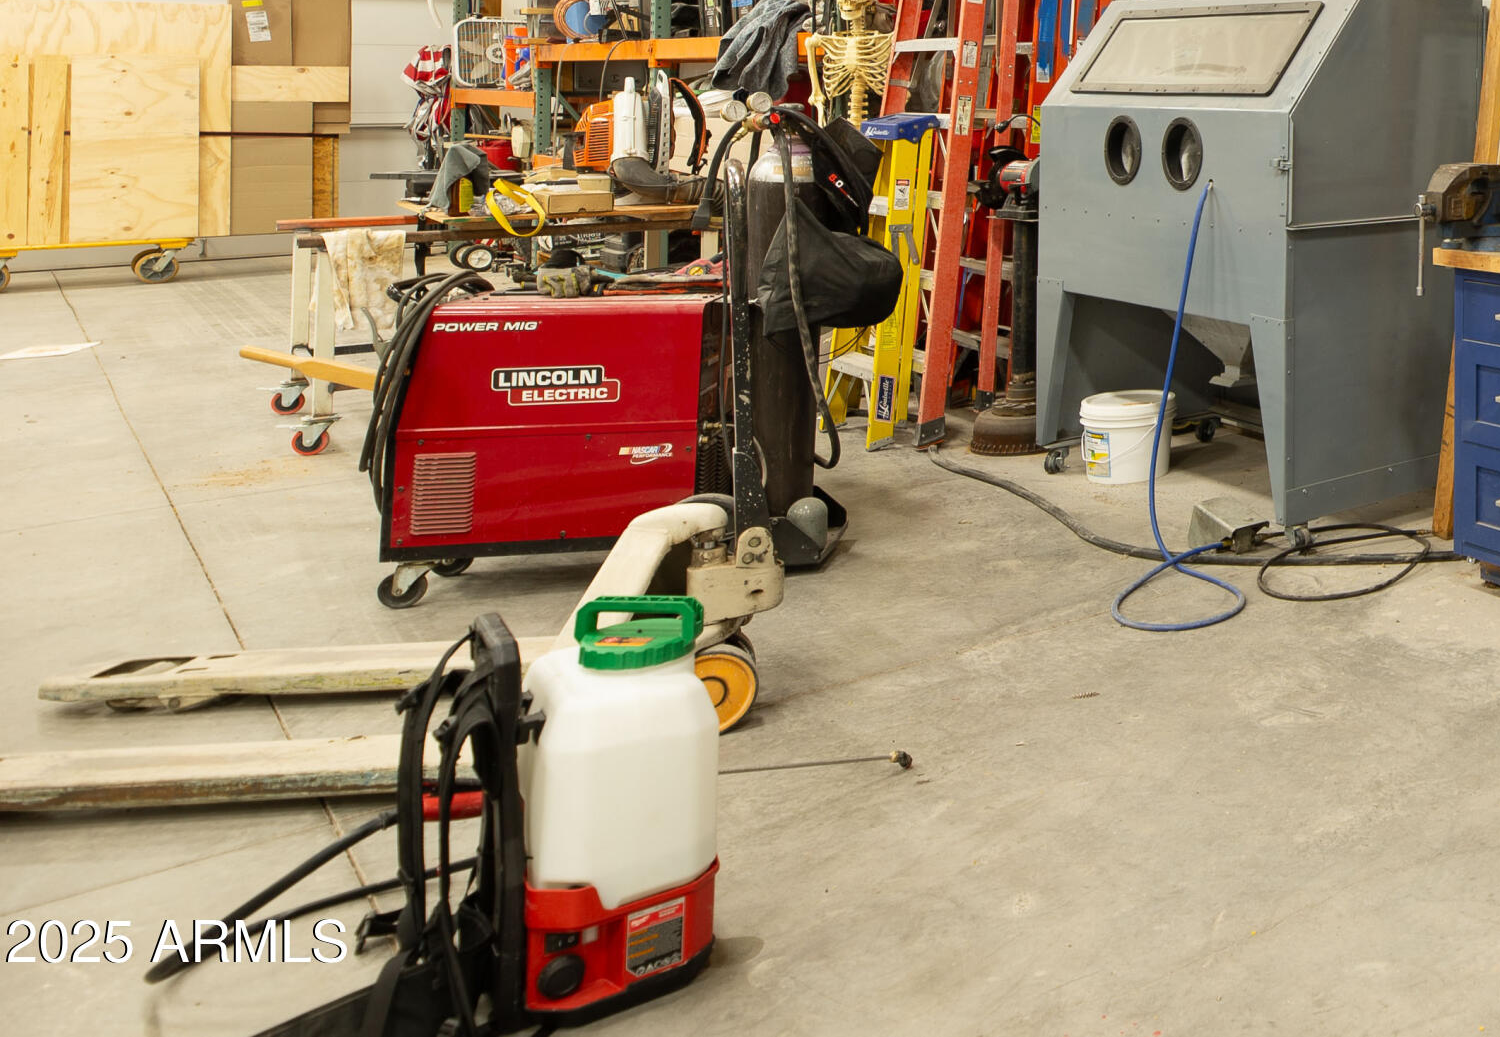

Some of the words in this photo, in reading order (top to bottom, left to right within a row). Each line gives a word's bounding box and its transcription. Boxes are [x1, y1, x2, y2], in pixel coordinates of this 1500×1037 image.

[432, 321, 499, 333] POWER
[503, 320, 539, 332] MIG
[498, 369, 598, 388] LINCOLN
[521, 387, 609, 402] ELECTRIC
[631, 445, 660, 454] NASCAR
